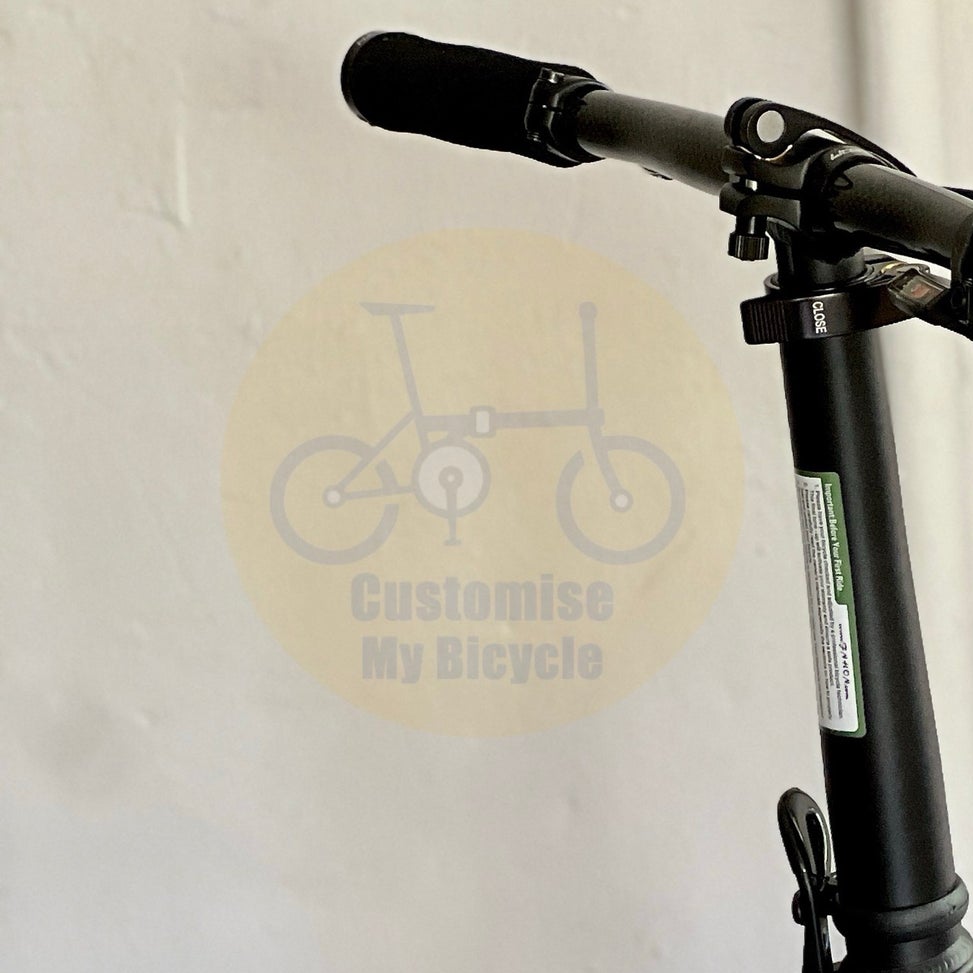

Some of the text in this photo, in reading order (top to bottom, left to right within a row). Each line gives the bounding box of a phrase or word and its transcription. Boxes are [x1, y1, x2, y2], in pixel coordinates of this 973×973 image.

[812, 301, 827, 334] CLOSE
[824, 483, 835, 517] Important
[829, 518, 839, 541] Before
[831, 541, 841, 559] Your
[833, 559, 842, 574] First
